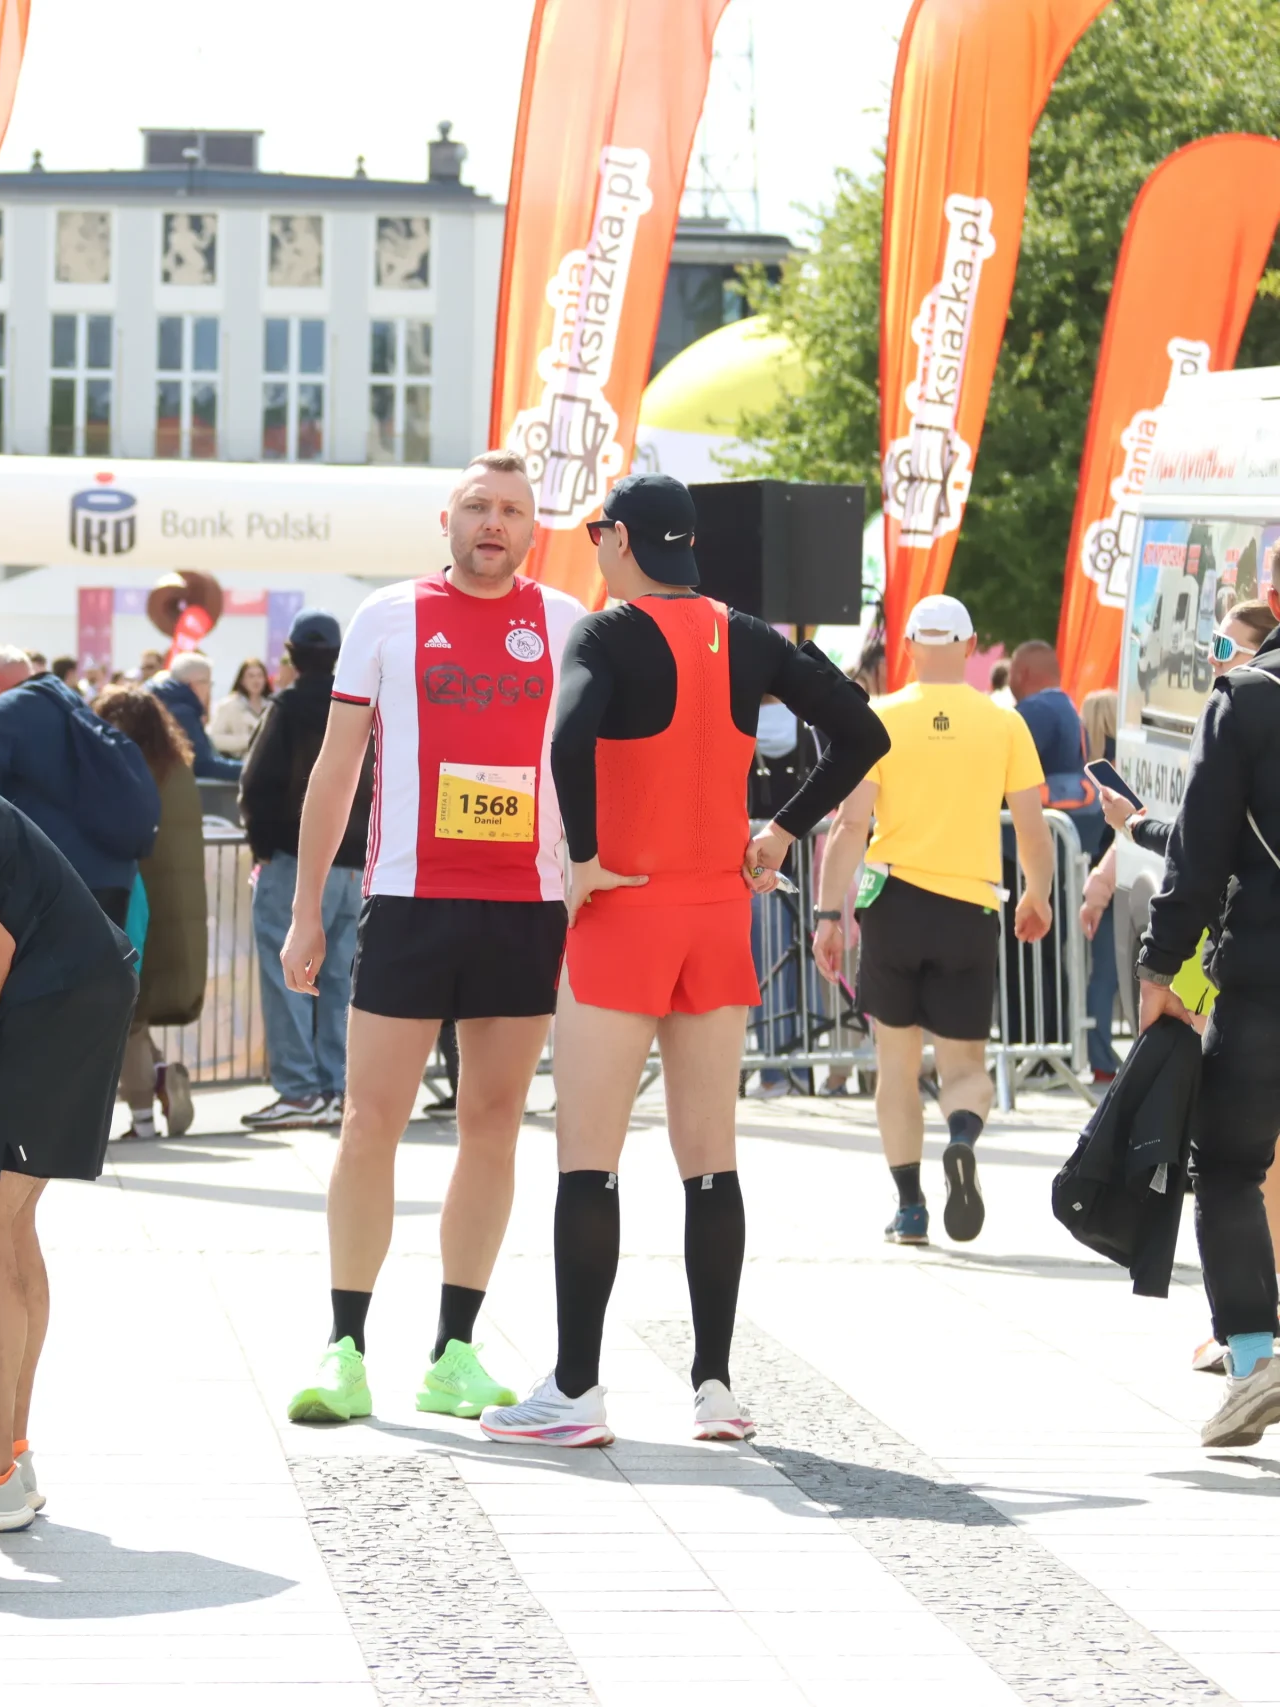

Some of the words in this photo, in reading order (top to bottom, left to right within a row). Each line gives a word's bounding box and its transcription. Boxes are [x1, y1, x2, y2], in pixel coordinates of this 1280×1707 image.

[568, 157, 641, 376] ksiazka.pl
[925, 206, 984, 407] ksiazka.pl
[1121, 419, 1157, 495] tania
[160, 508, 235, 540] Bank
[246, 511, 331, 542] Polski
[423, 641, 452, 649] adidas
[507, 629, 523, 643] AJAX
[459, 793, 518, 816] 1568
[474, 816, 502, 825] Daniel
